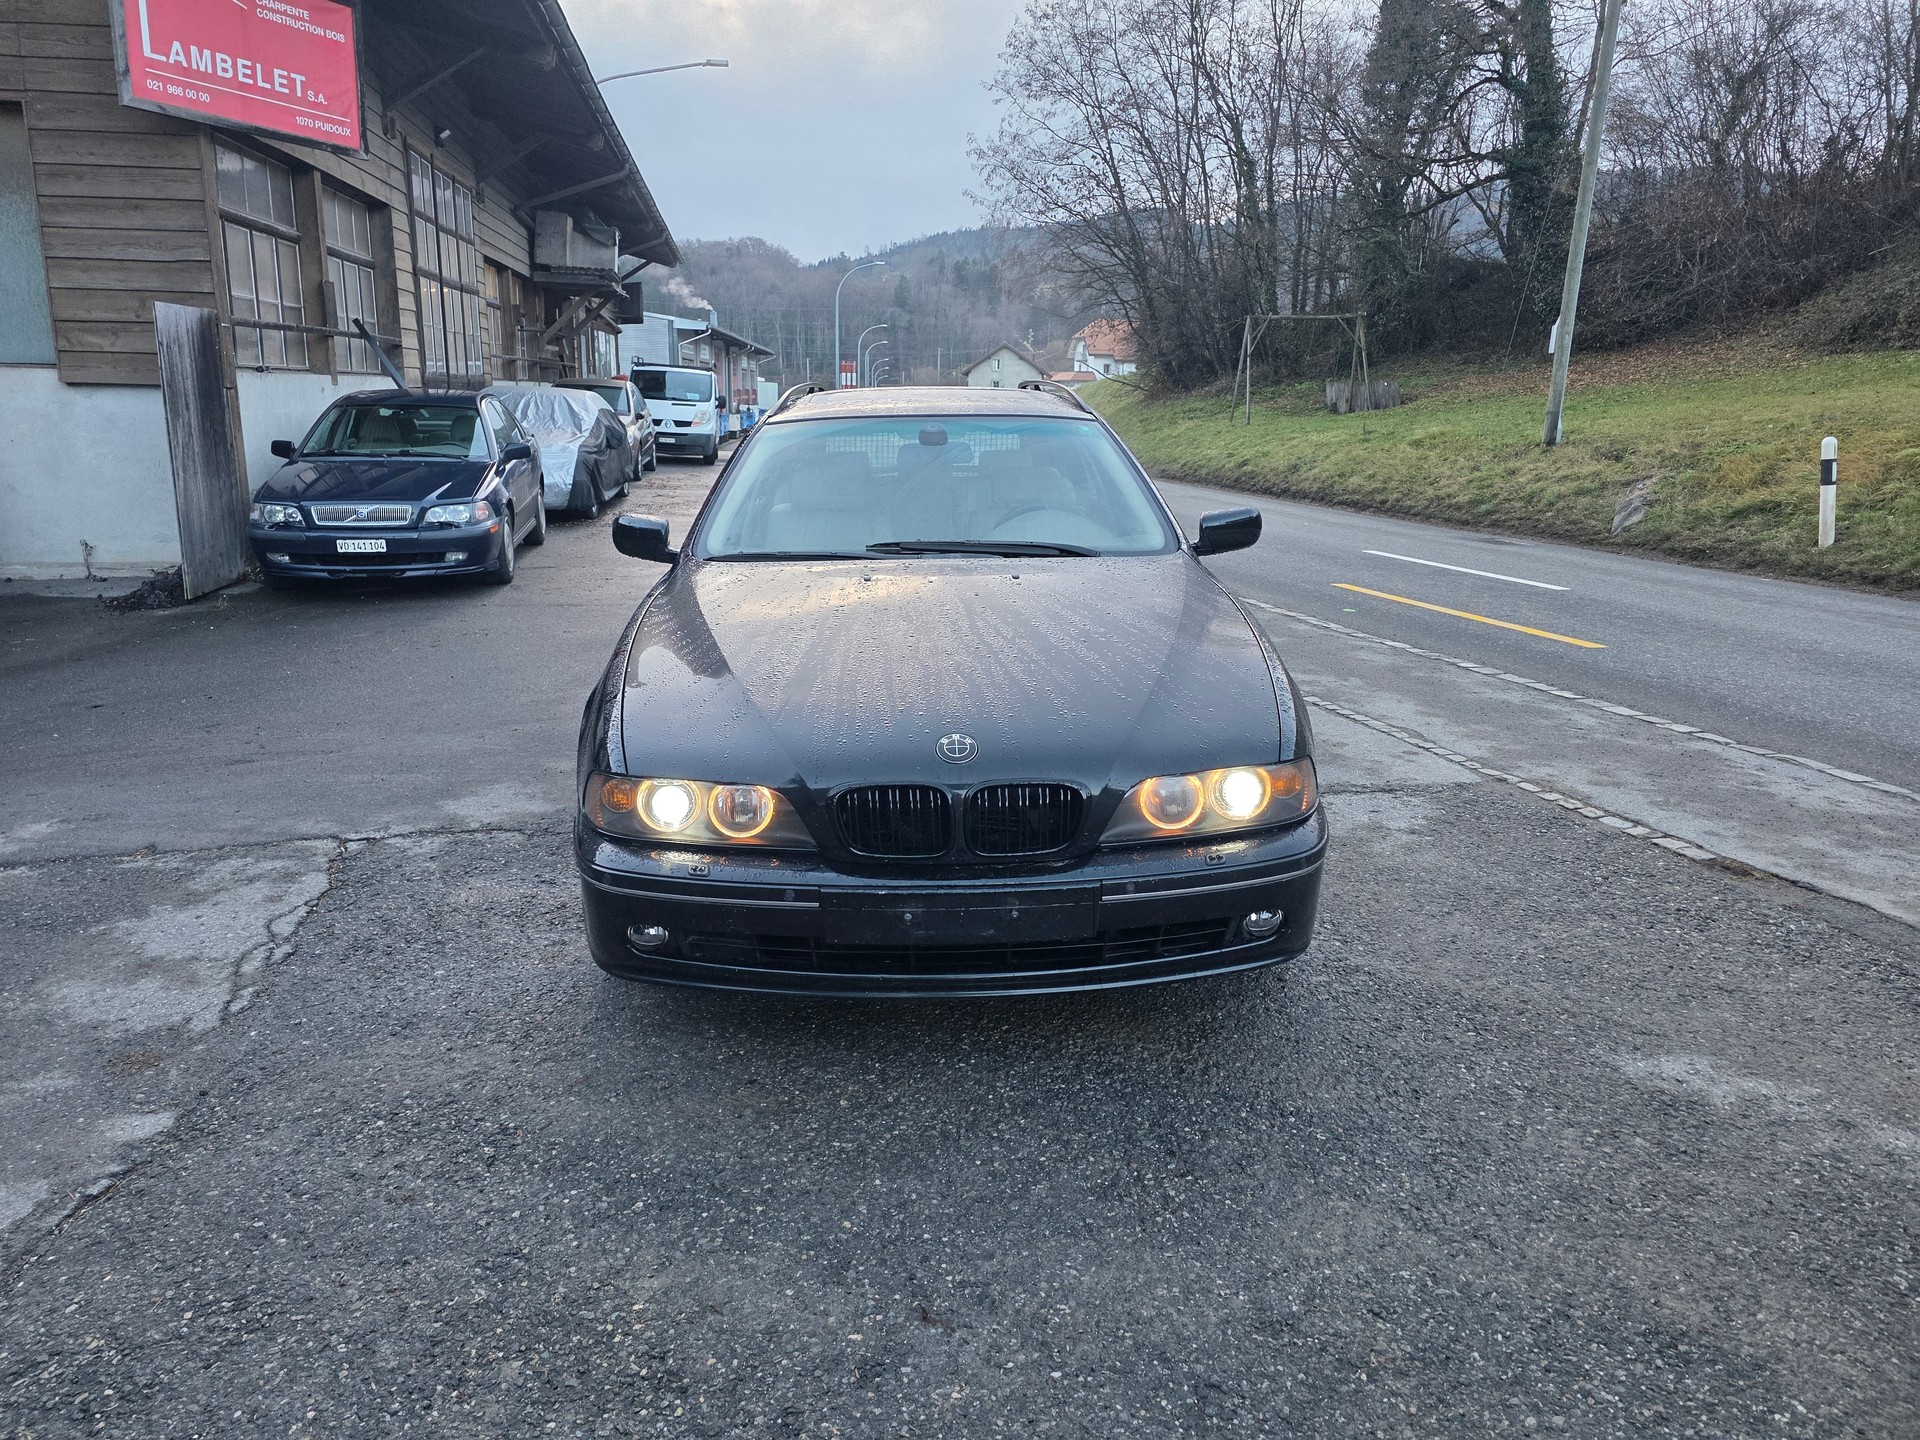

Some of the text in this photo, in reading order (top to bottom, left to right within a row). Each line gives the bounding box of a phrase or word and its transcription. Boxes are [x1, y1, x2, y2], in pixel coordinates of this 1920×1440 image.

[256, 0, 310, 20] CHARPENTE
[256, 8, 345, 43] CONSTRUCTION BOIS
[138, 0, 328, 105] LAMBELET S.A.
[146, 79, 210, 102] 021 966 00 00
[295, 116, 352, 137] 1070 PUIDOUX
